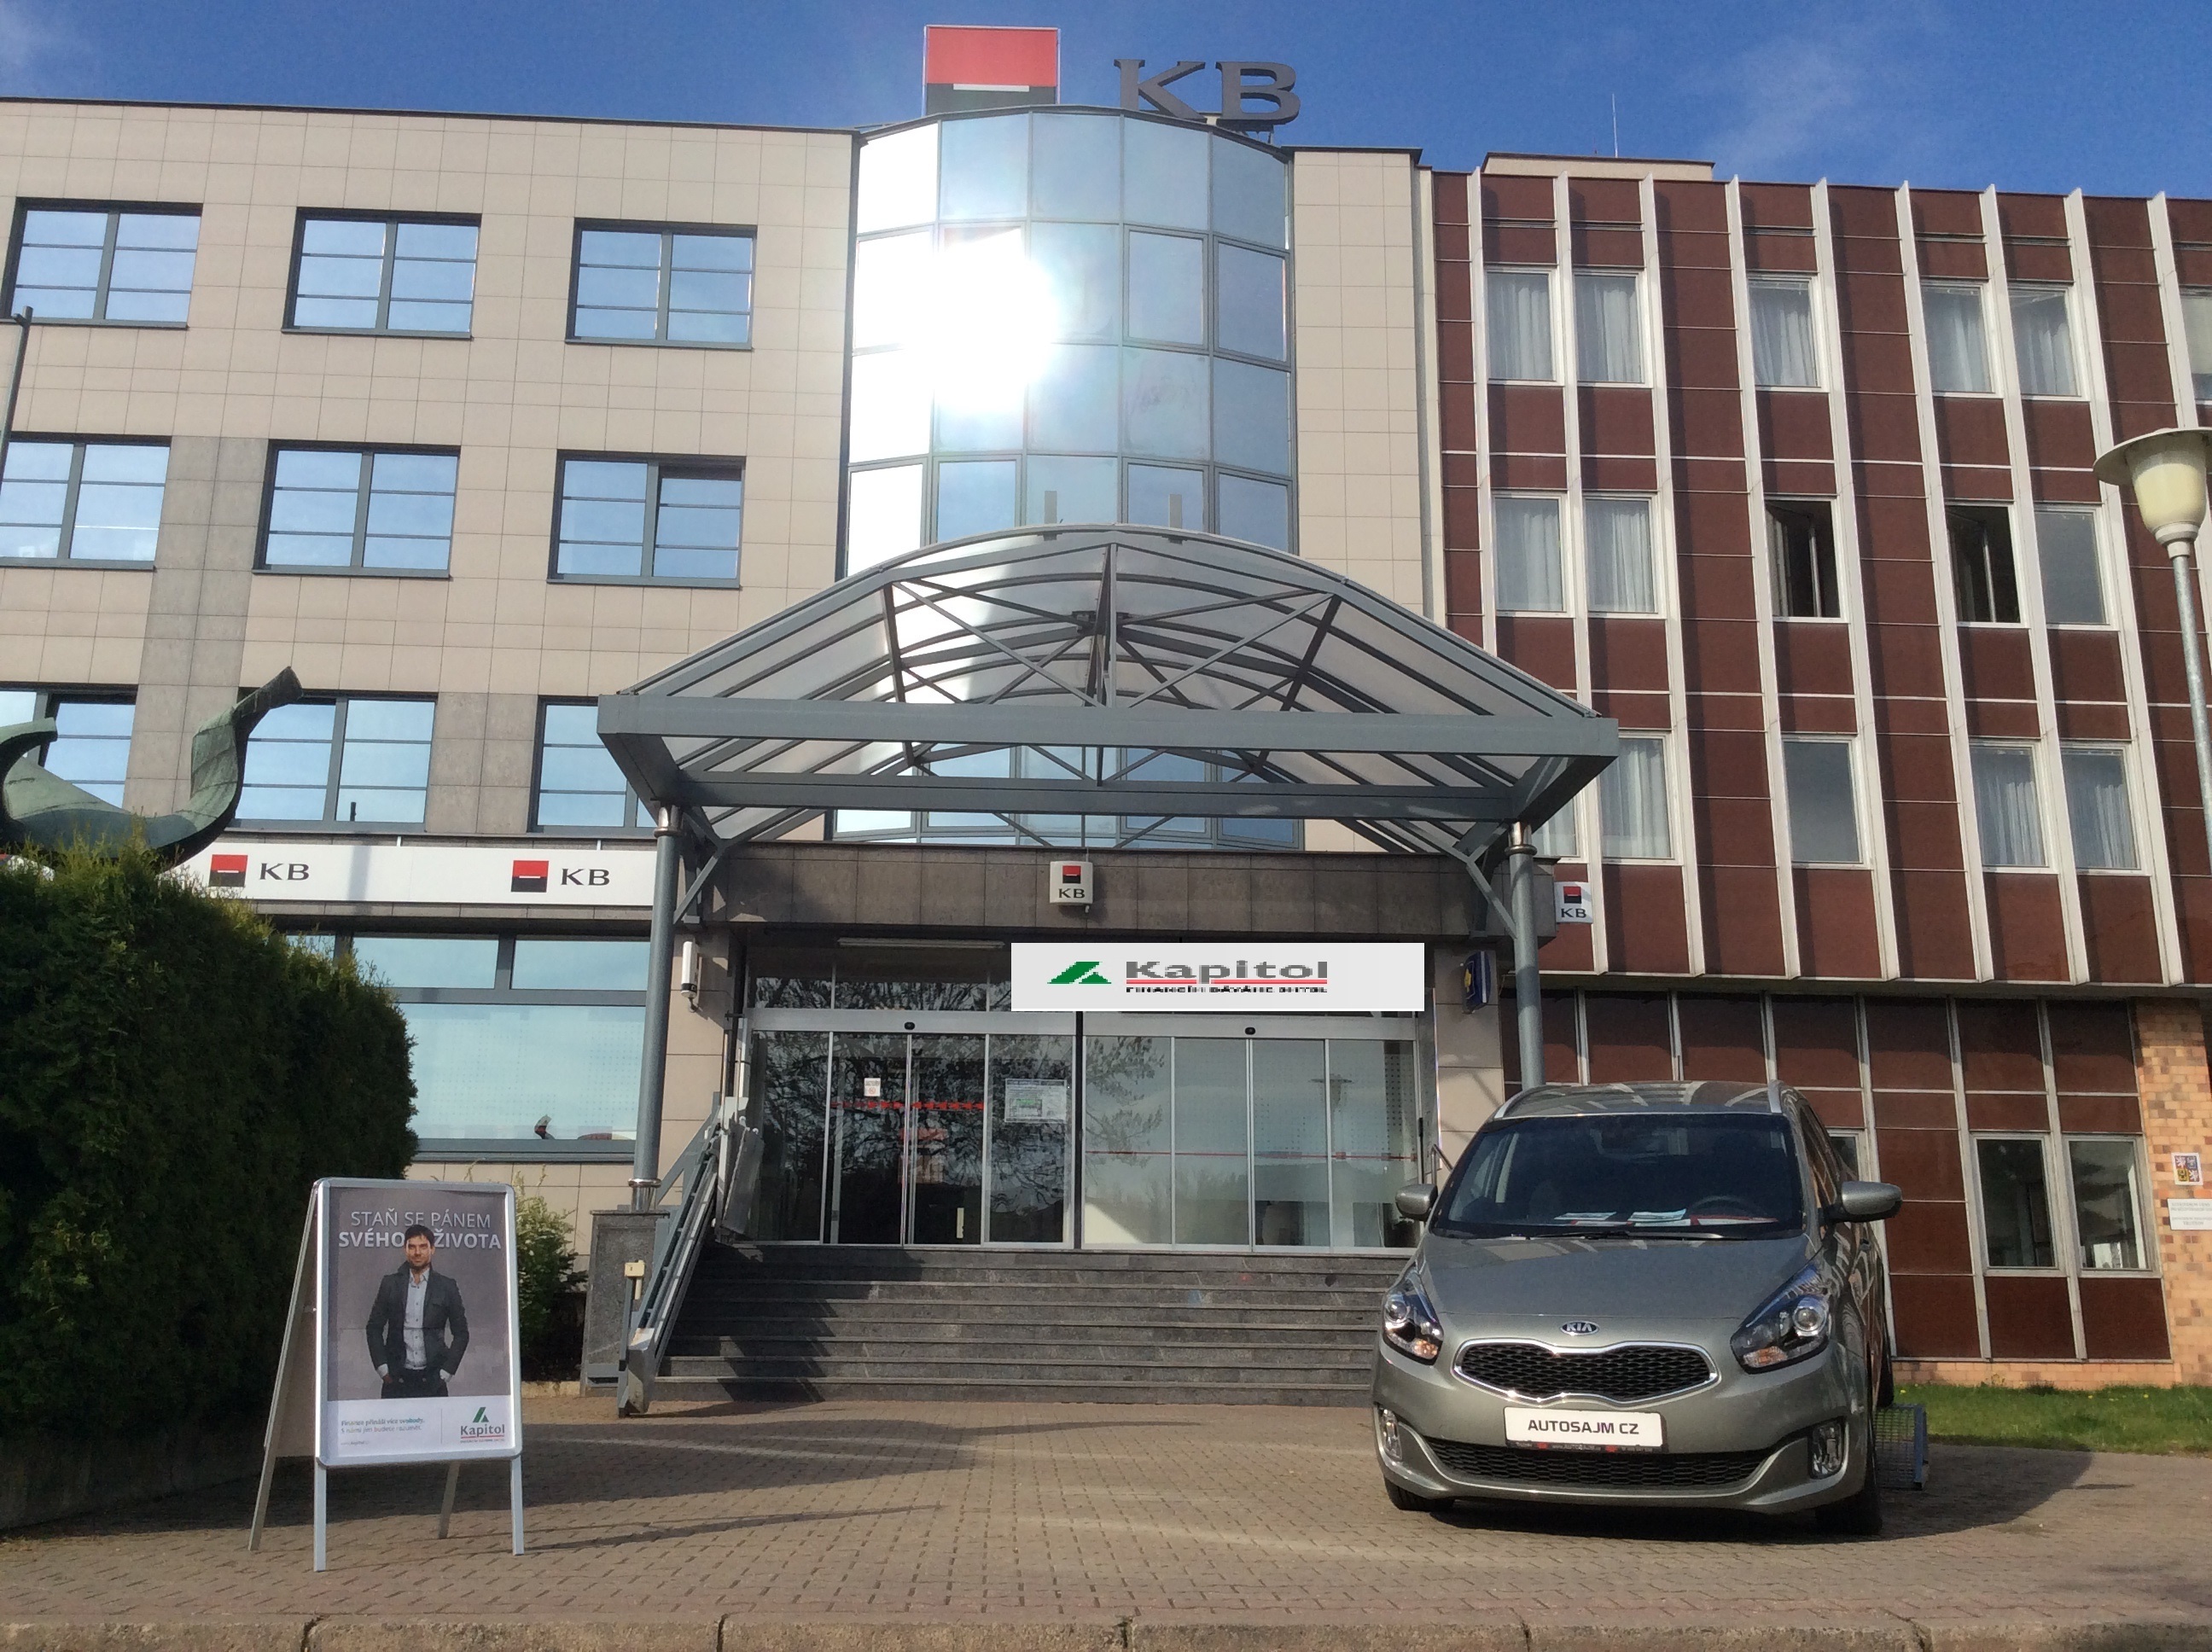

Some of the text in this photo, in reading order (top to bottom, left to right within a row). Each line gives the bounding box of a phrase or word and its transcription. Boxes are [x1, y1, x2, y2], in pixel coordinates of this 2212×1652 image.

[1114, 59, 1301, 125] KB
[259, 863, 310, 881] KB
[561, 868, 610, 886] KB
[1058, 888, 1086, 899] KB
[1561, 908, 1587, 918] KB
[351, 1207, 491, 1228] STAŇ SE PÁNEM
[338, 1228, 502, 1249] SVÉHO ŽIVOTA
[1566, 1323, 1592, 1331] KIA
[460, 1424, 505, 1437] Kapitol
[1528, 1419, 1639, 1435] AUTOSAJM CZ
